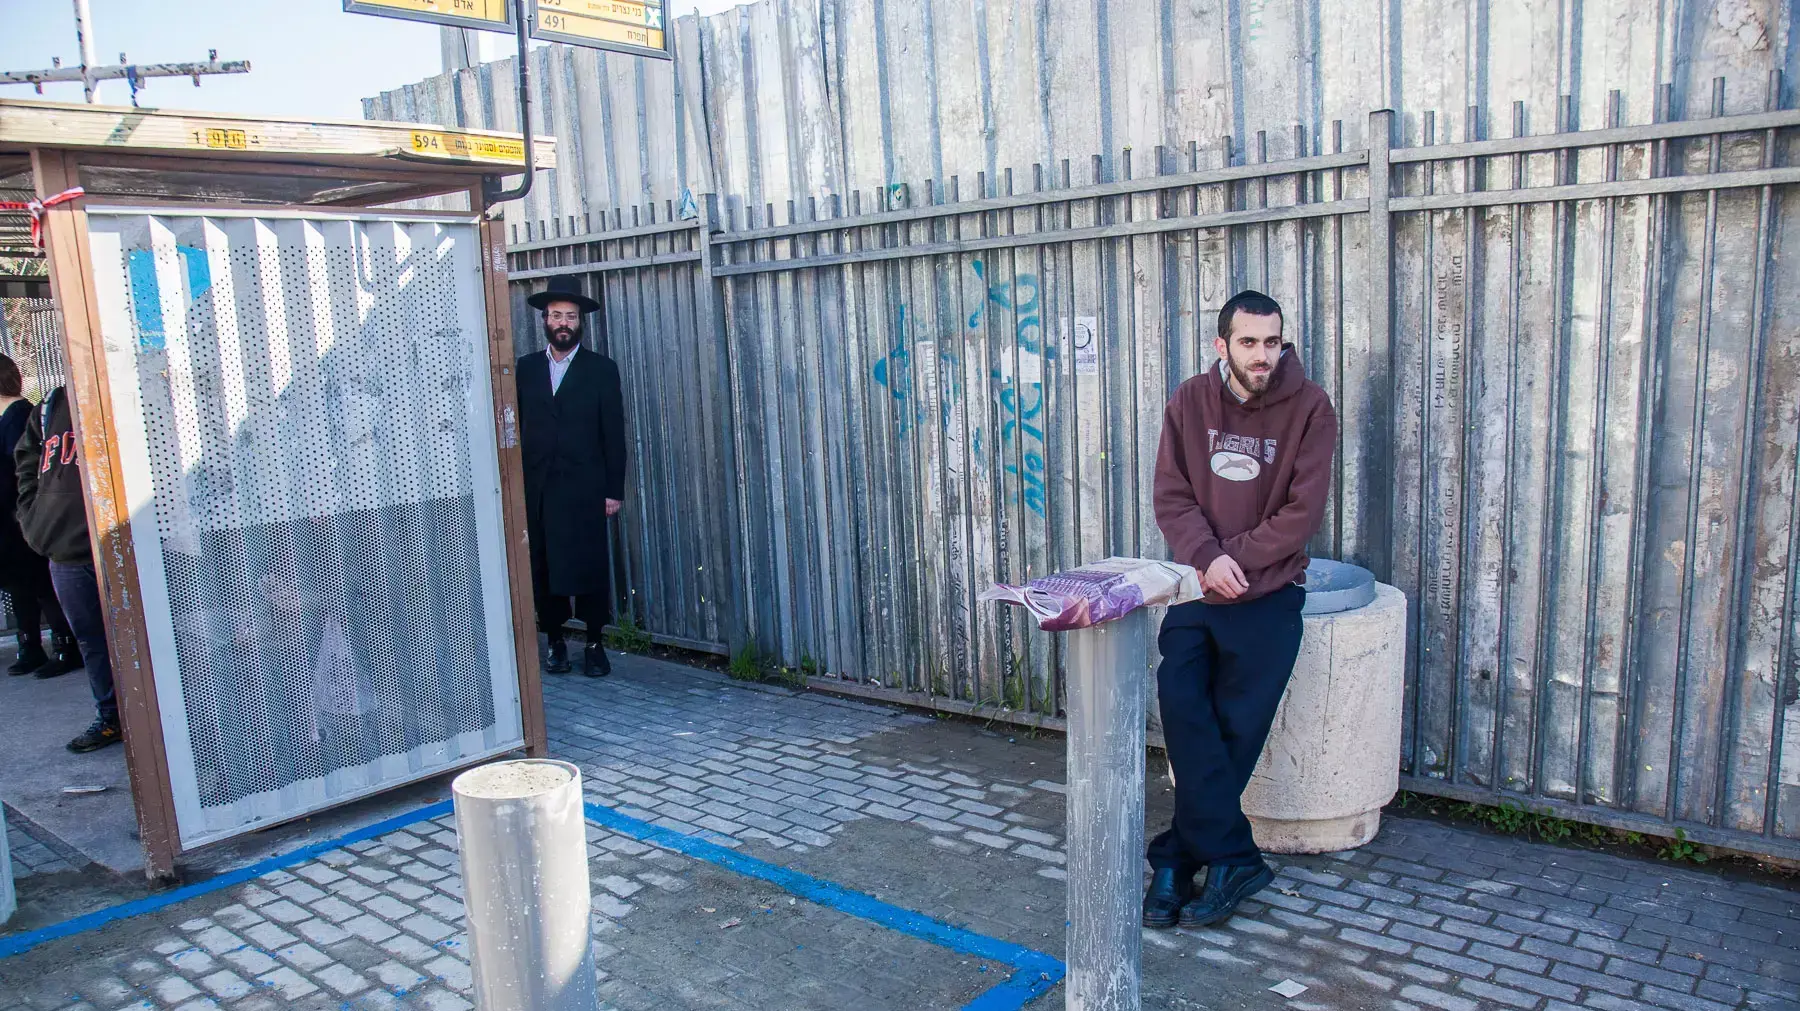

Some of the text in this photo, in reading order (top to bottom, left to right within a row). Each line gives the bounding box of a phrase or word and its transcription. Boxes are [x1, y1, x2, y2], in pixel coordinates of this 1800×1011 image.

[454, 0, 473, 10] אדם
[544, 15, 565, 30] 491
[627, 30, 646, 43] תפרח
[414, 135, 438, 149] 594
[42, 431, 80, 473] FO
